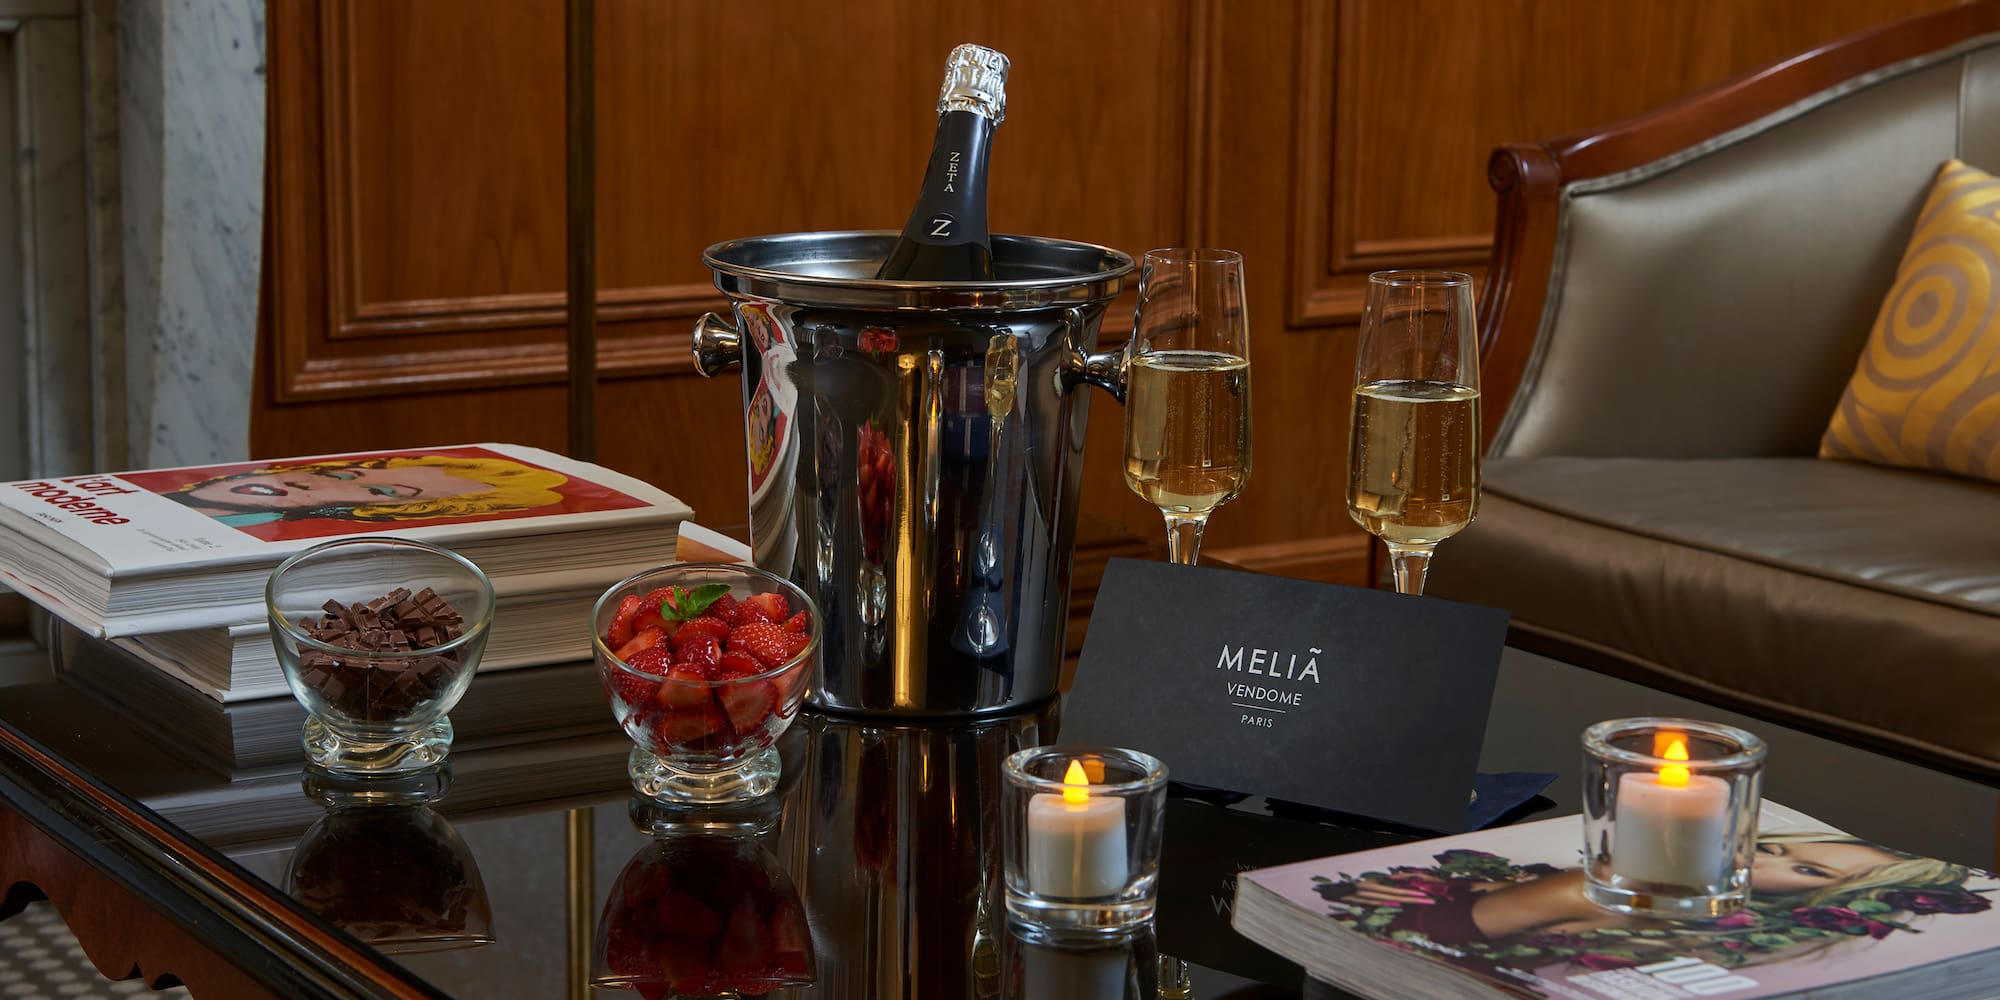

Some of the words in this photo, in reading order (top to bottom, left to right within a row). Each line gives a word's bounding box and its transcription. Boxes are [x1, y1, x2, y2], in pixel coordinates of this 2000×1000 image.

[944, 152, 961, 193] ZETA
[930, 219, 952, 236] Z
[11, 481, 131, 525] moderne
[1227, 681, 1303, 706] VENDOME
[1240, 714, 1273, 728] PARIS
[1635, 956, 1760, 996] 100
